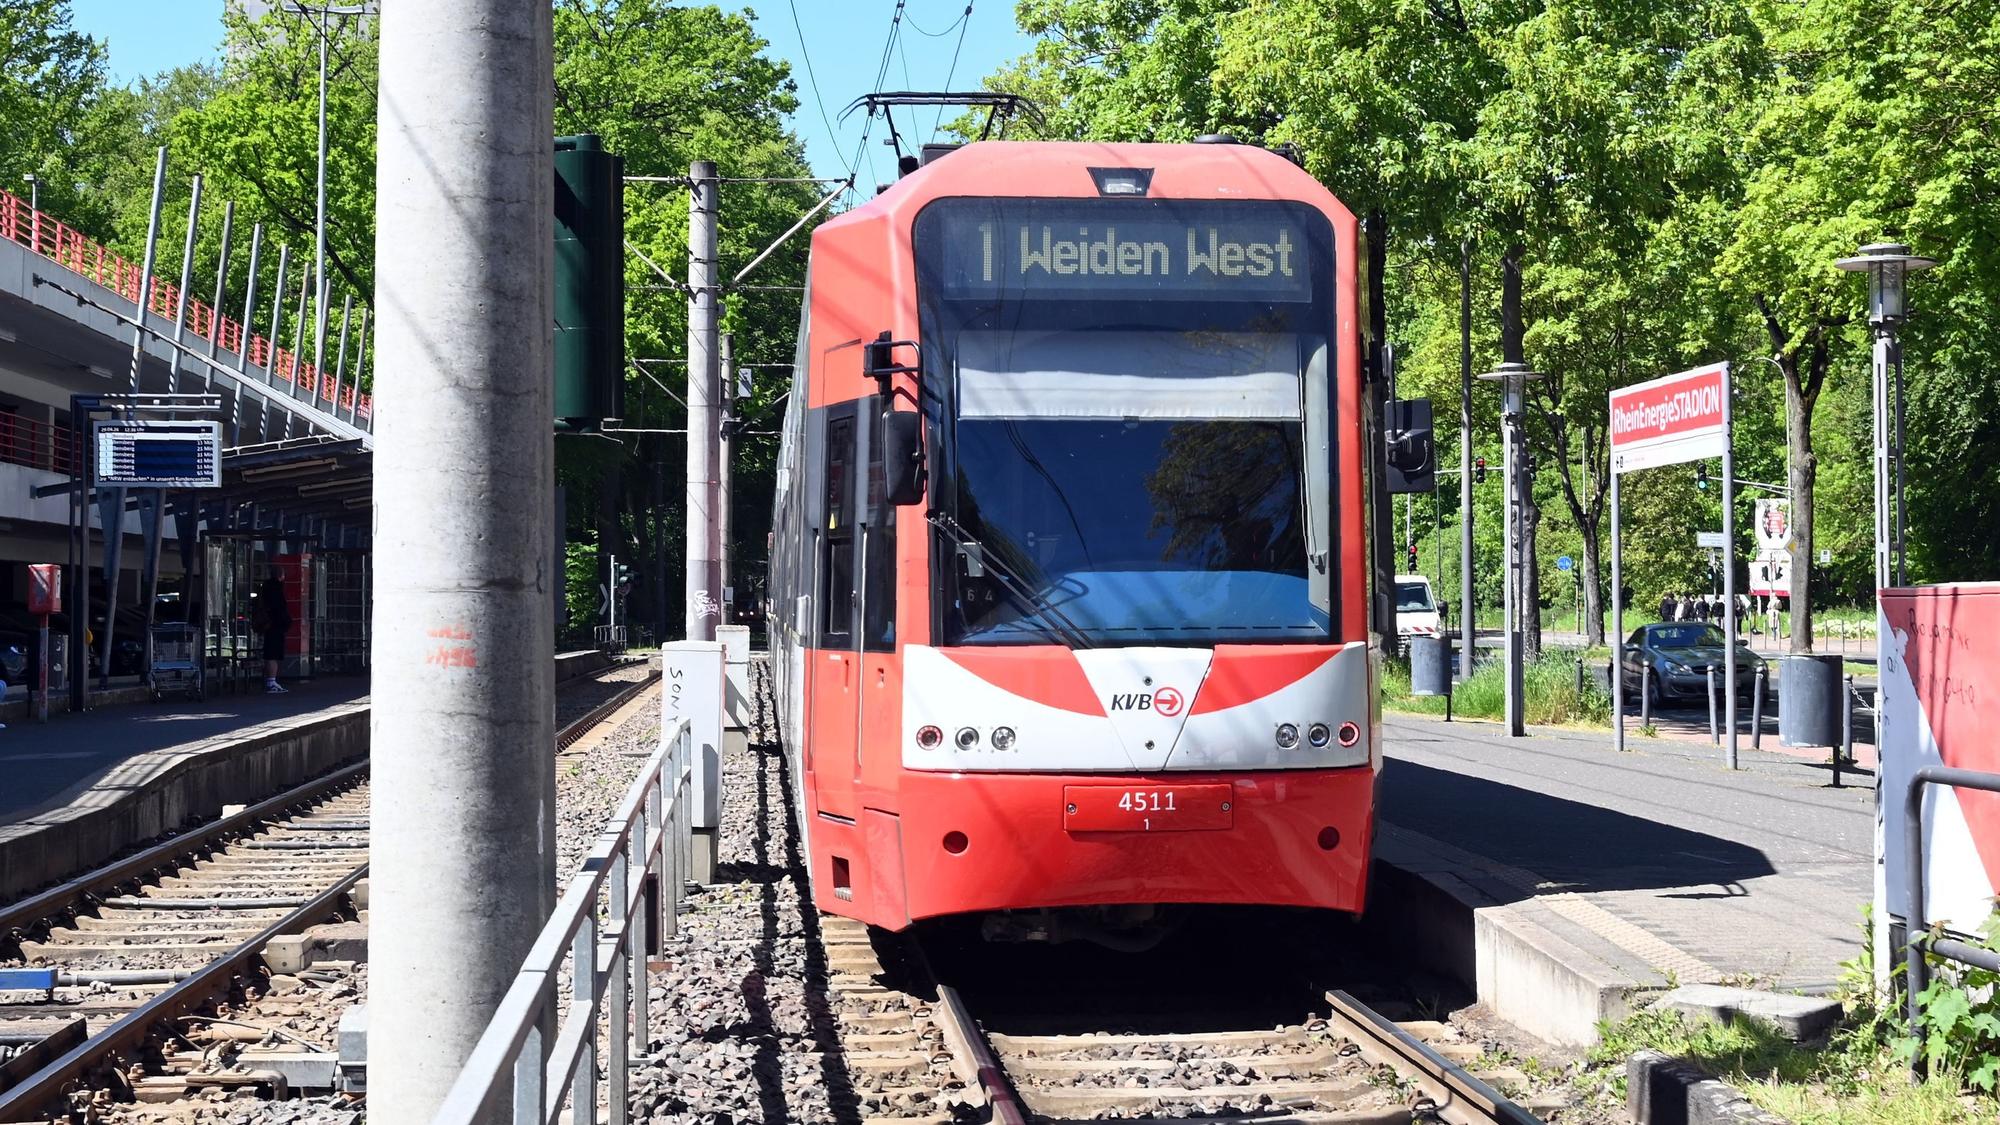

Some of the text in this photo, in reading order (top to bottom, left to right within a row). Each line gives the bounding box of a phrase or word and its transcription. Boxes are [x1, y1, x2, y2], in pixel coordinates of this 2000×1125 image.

[978, 223, 1293, 281] 1 Weiden West
[1614, 384, 1720, 434] RheinEnergieSTADION
[1111, 694, 1152, 711] KVB
[1118, 791, 1177, 812] 4511
[1143, 818, 1151, 831] 1
